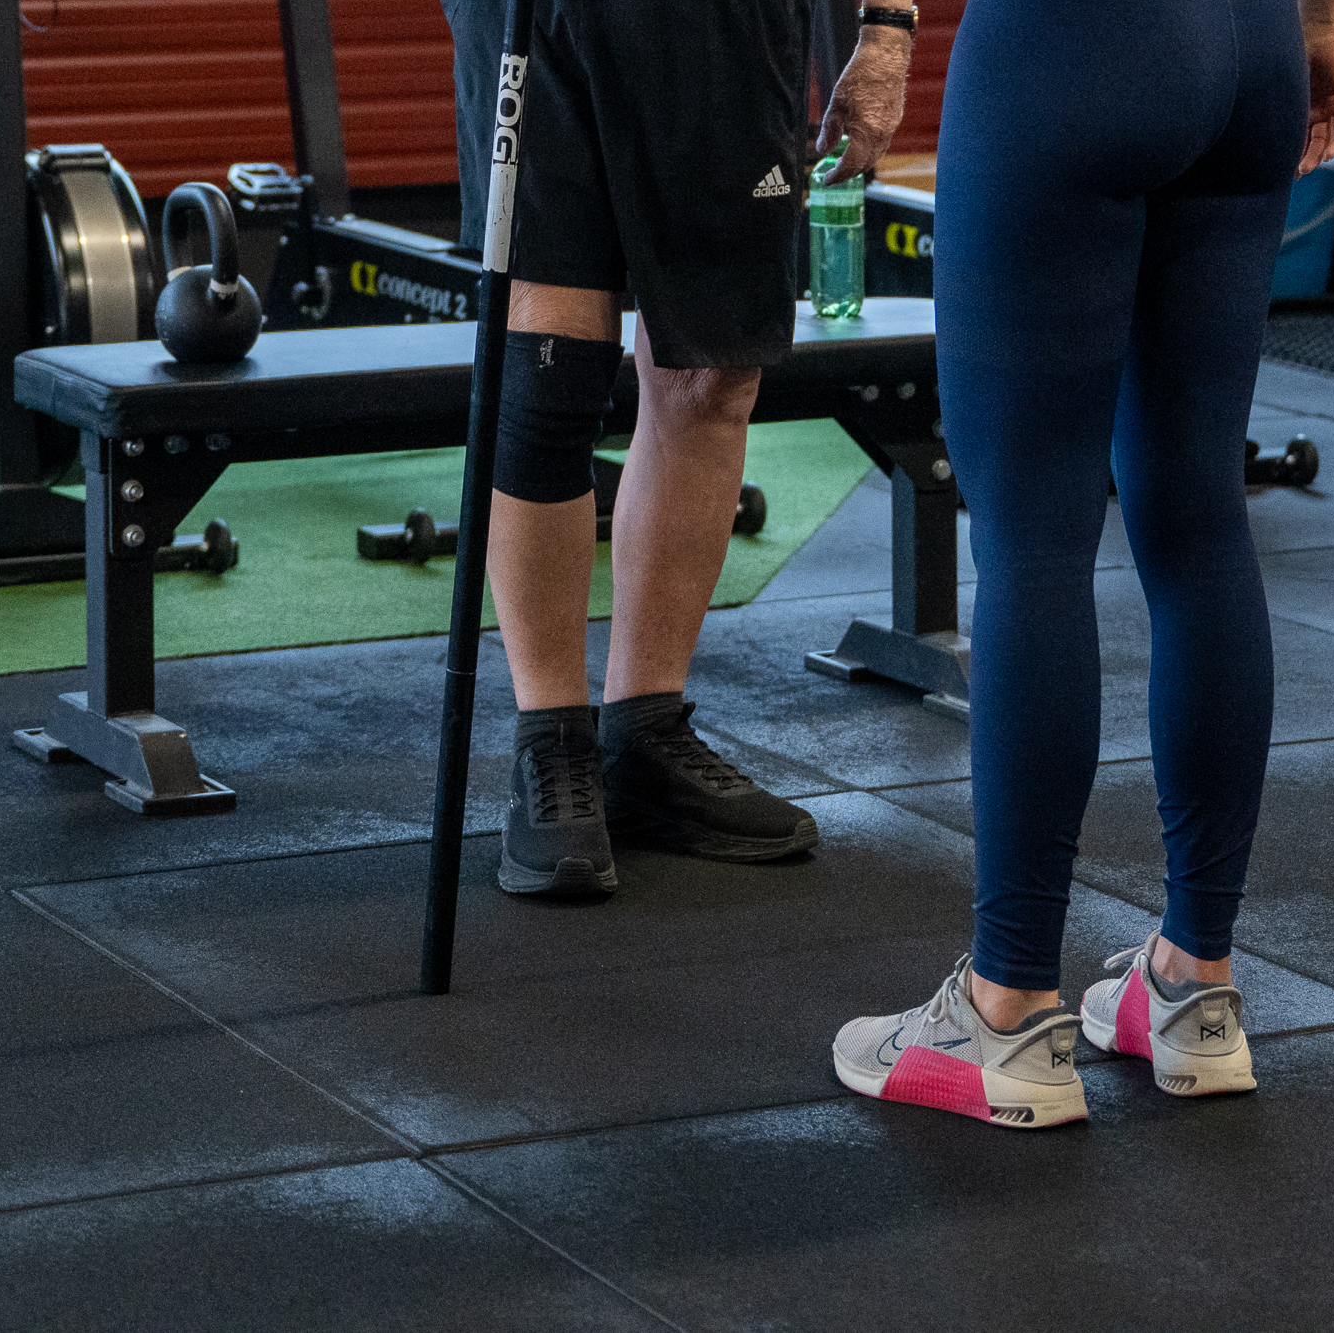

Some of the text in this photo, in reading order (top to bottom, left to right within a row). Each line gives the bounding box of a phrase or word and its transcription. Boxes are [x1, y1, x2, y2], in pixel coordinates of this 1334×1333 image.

[752, 183, 792, 199] adidas
[378, 272, 451, 315] concept
[454, 293, 468, 320] 2
